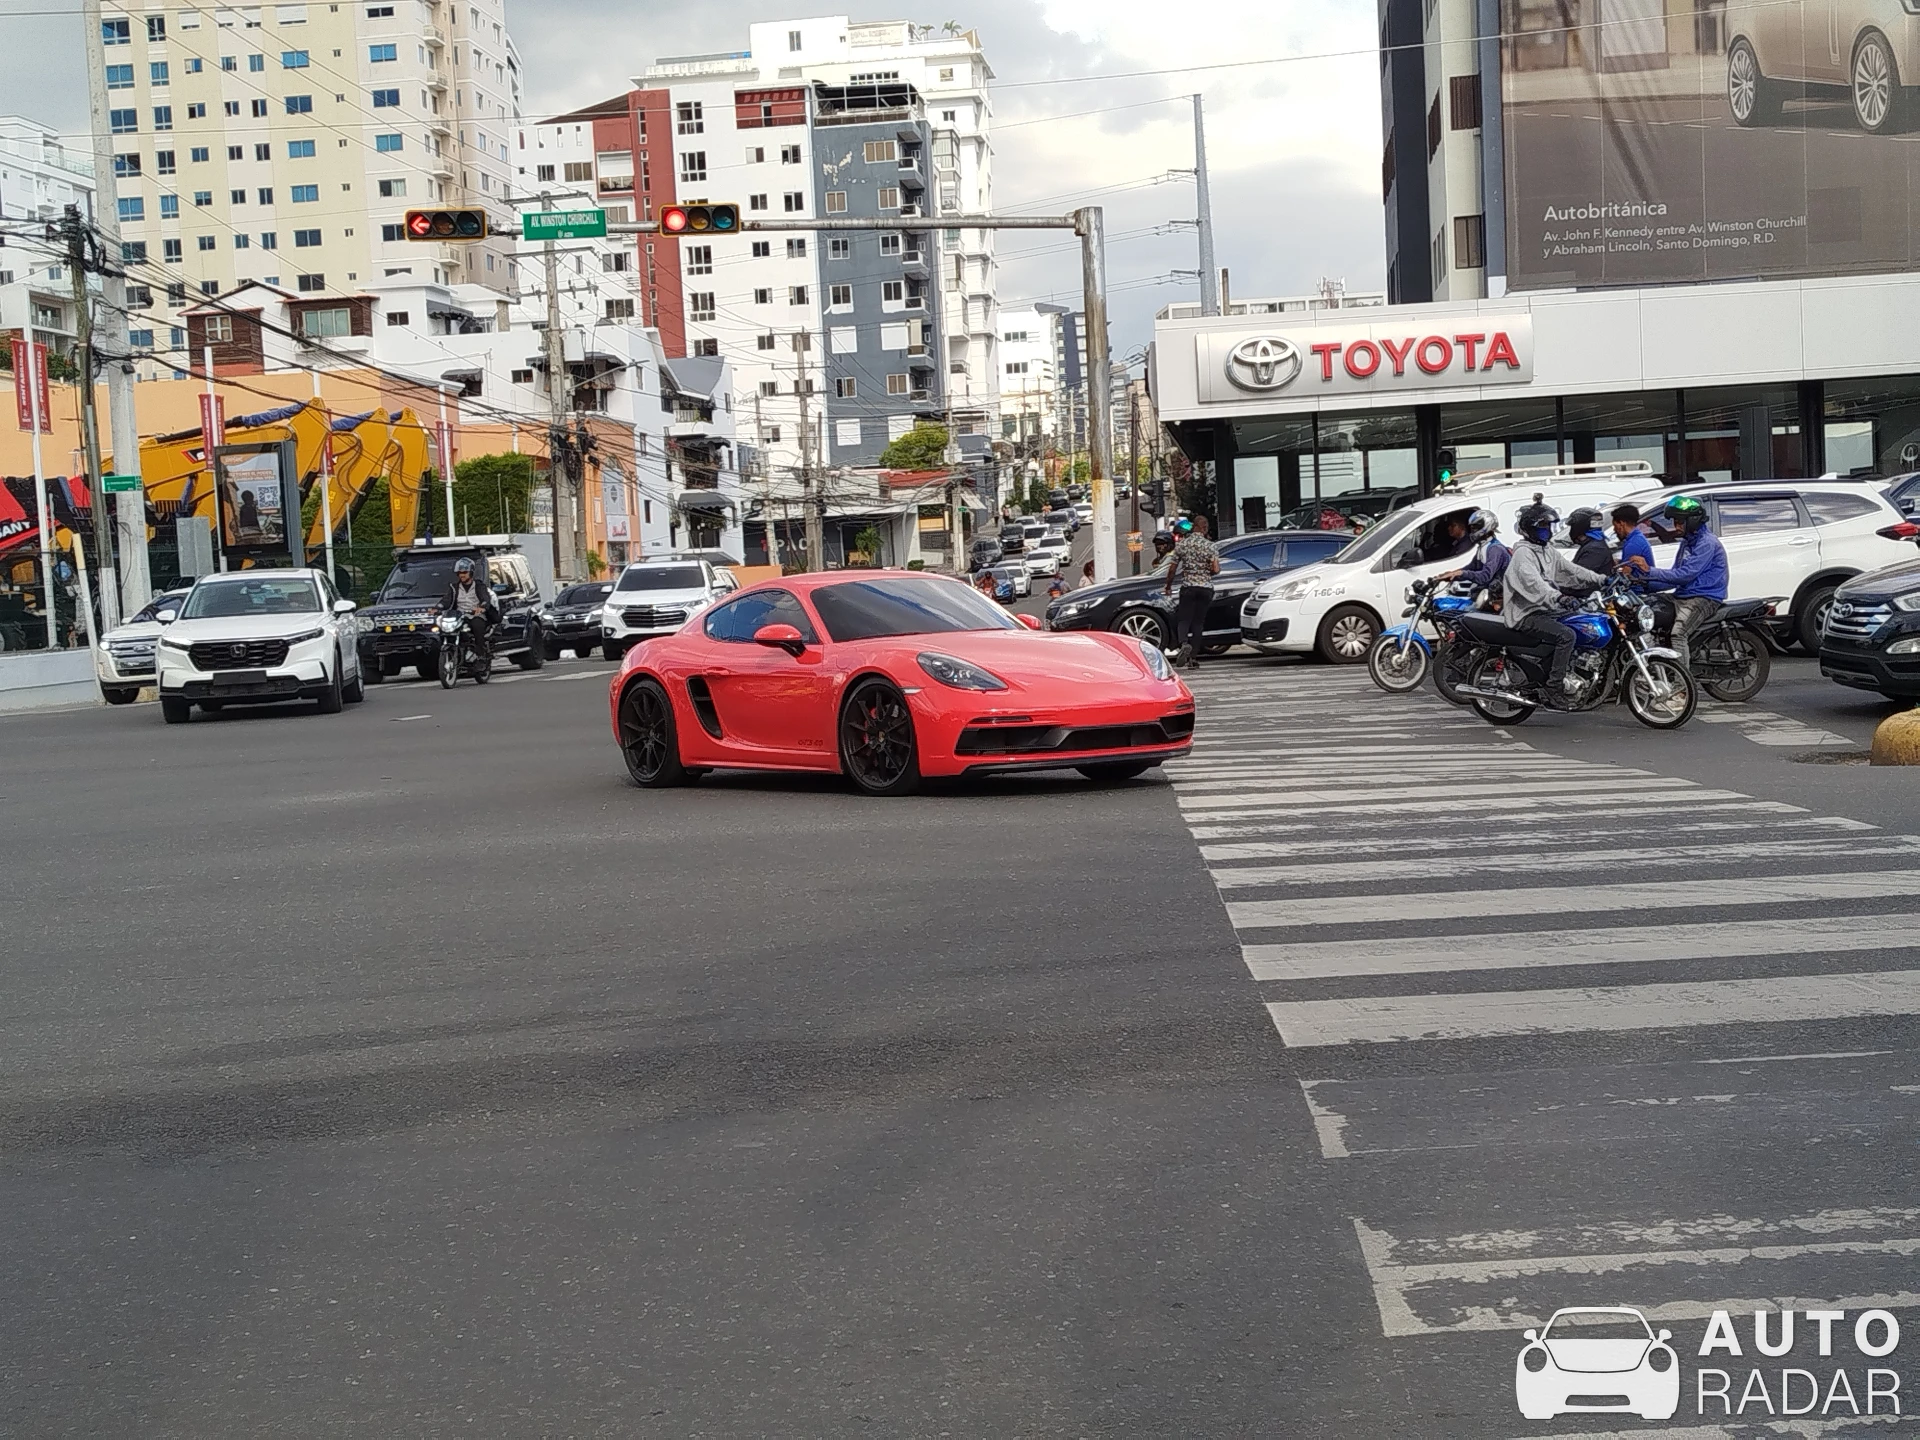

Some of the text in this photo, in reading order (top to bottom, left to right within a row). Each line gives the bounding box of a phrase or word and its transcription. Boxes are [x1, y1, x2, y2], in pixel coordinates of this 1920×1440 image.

[541, 213, 567, 227] WINSTON
[567, 212, 599, 226] CHURCHILL
[1543, 200, 1668, 221] Autobritánica
[1543, 215, 1806, 241] Av. John F. Kennedy entre Av. Winston Churchill
[1543, 232, 1777, 259] y Abraham Lincoln, Santo Domingo, R.D.
[1310, 332, 1520, 382] TOYOTA
